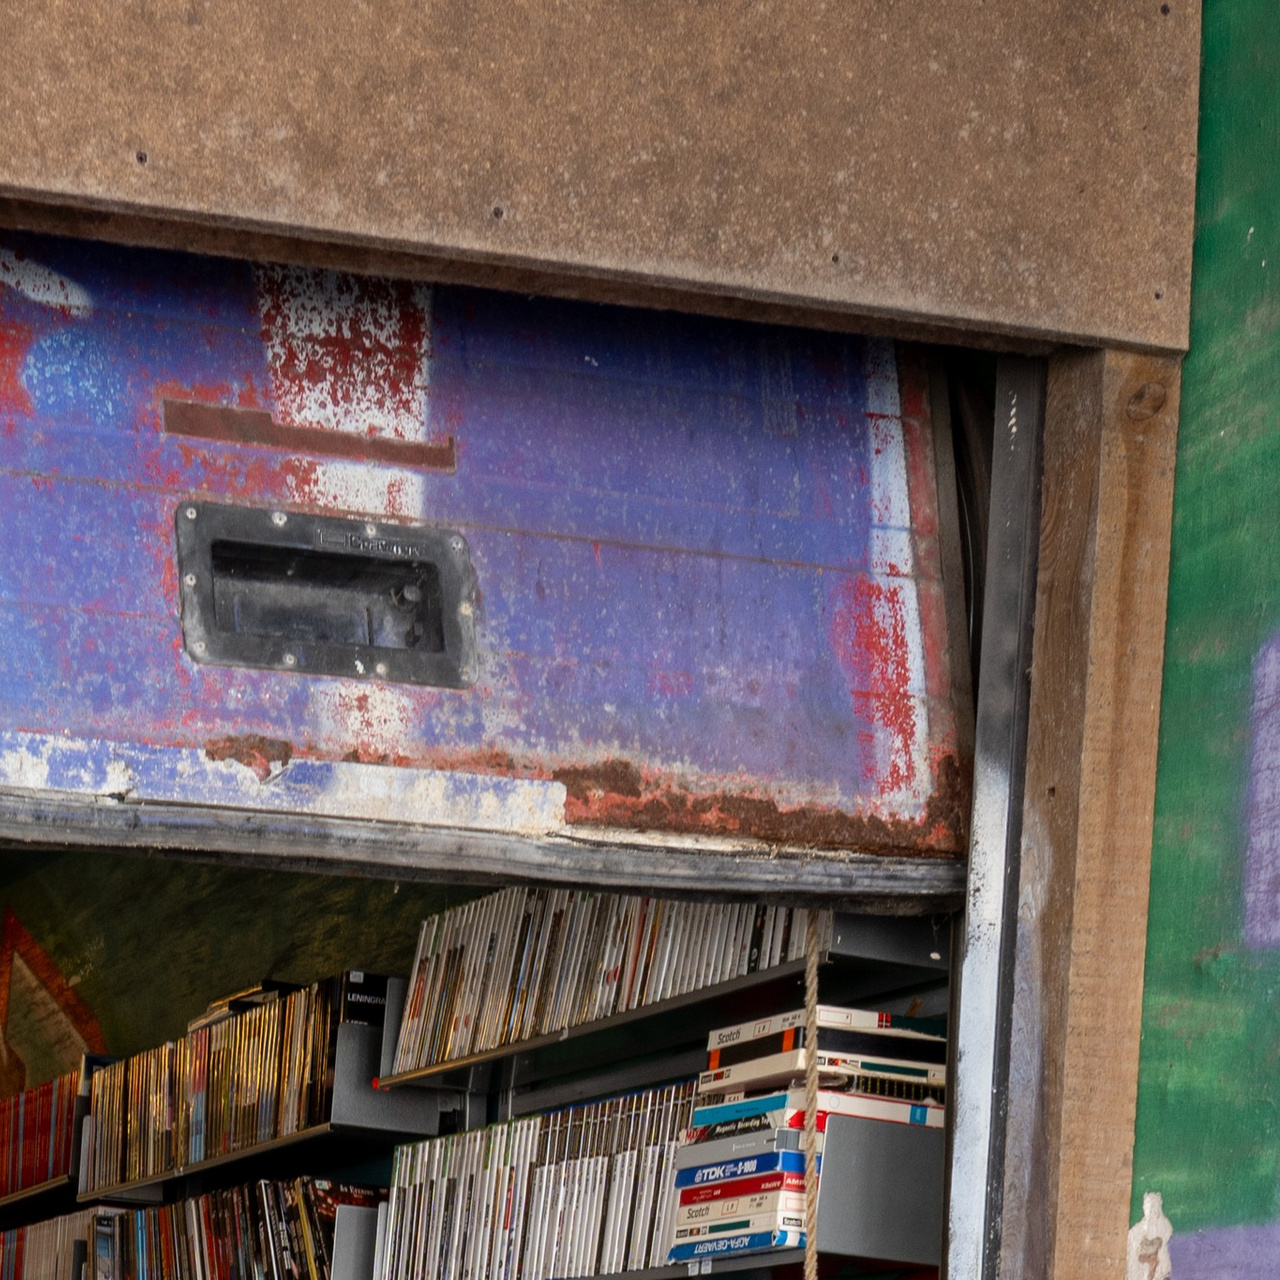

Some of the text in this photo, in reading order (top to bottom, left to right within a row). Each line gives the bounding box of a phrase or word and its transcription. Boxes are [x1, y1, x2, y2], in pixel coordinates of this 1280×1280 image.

[347, 992, 386, 1005] LENINGRA
[717, 1028, 741, 1044] Scotch
[715, 1123, 736, 1134] Magnetic
[702, 1166, 725, 1181] TDK
[761, 1180, 781, 1190] AMPEX
[687, 1204, 710, 1219] Scotch
[694, 1236, 750, 1254] AGFA-GEVAERT
